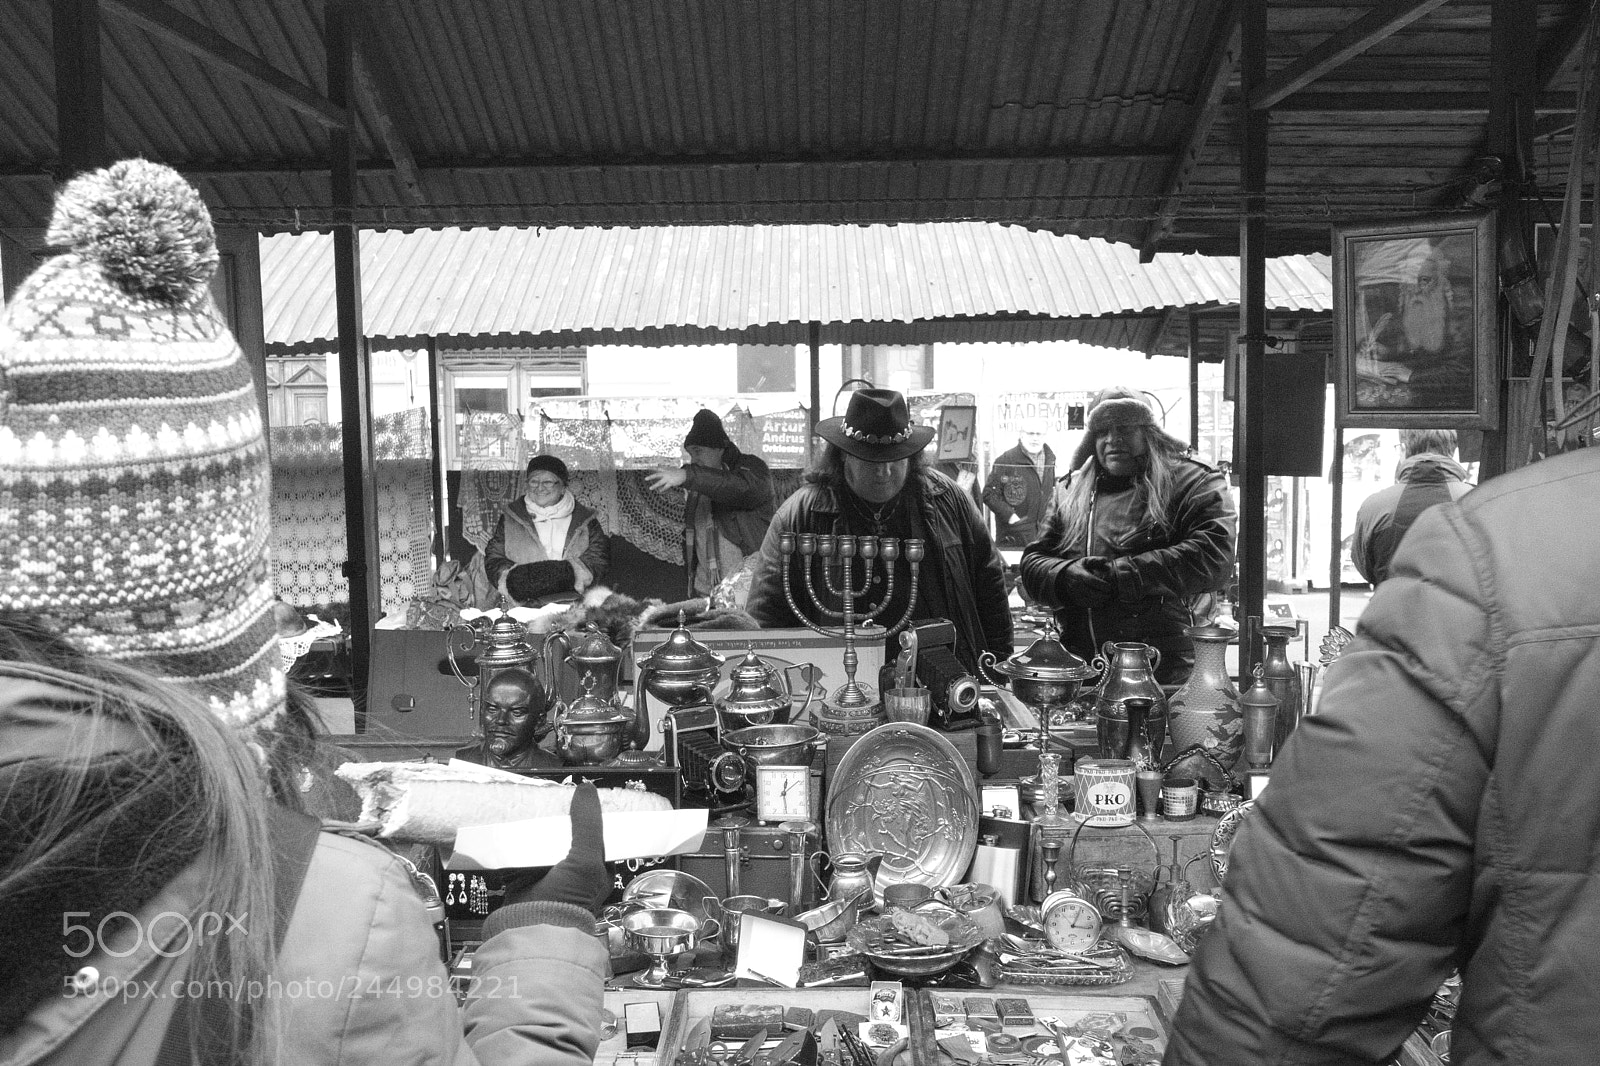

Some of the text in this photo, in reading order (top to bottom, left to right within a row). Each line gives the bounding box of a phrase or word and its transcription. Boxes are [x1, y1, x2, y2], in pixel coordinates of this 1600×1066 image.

[763, 420, 805, 432] Artur
[763, 432, 805, 443] Andrus
[1095, 793, 1125, 805] PKO
